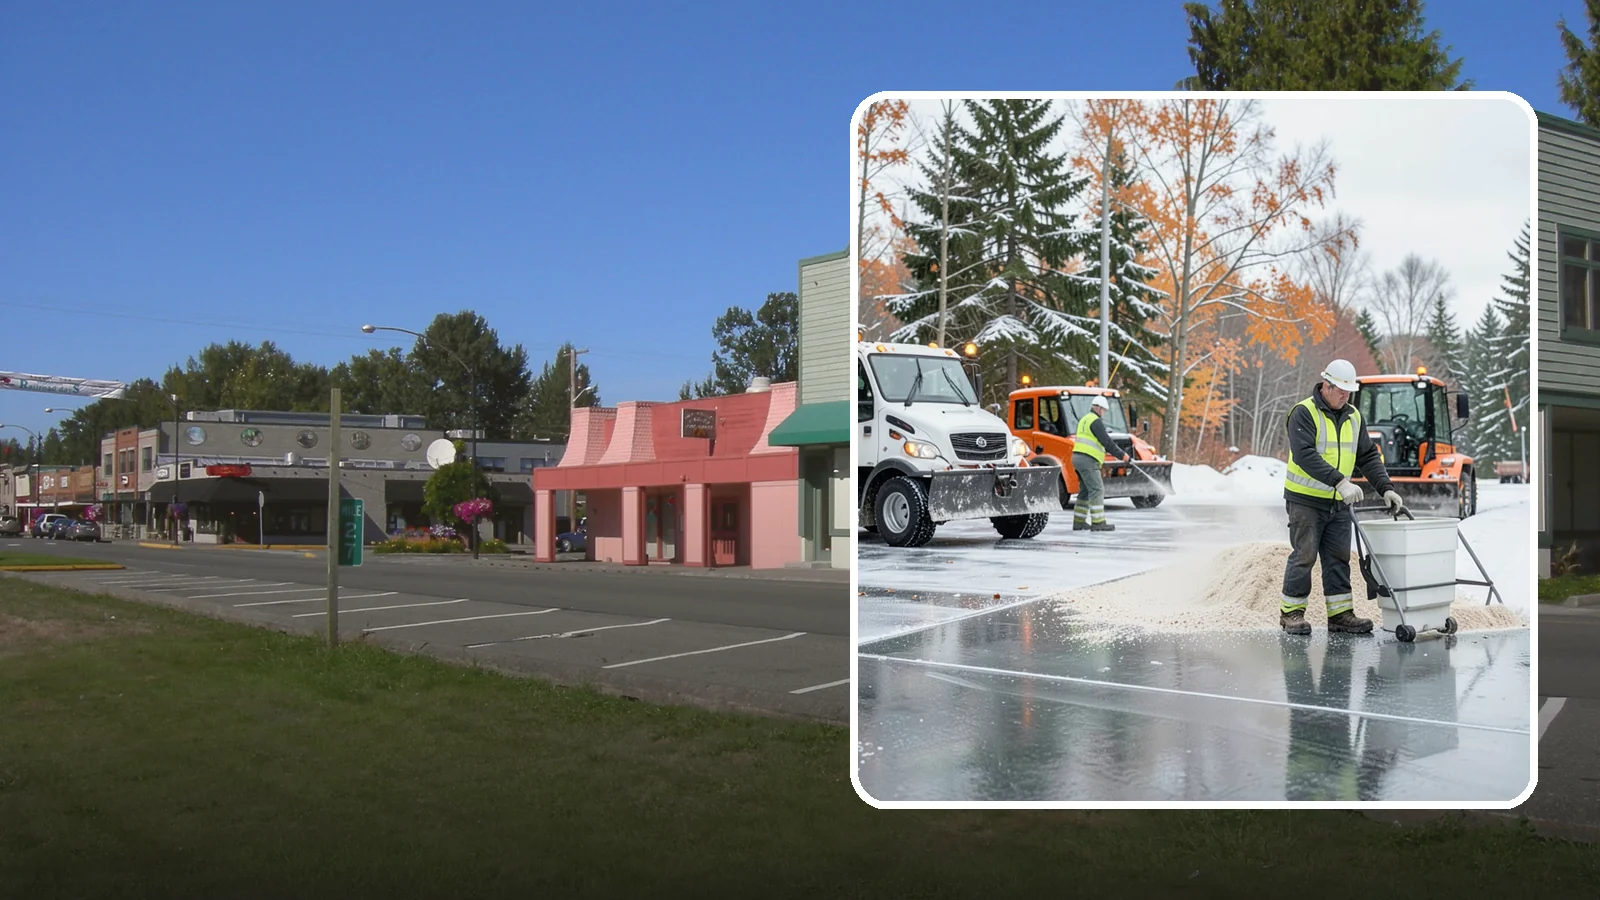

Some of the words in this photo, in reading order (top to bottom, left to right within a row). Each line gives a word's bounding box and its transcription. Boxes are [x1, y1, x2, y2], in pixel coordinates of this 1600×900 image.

[20, 379, 57, 392] Railroad
[341, 505, 362, 517] MILE
[344, 522, 357, 539] 2
[344, 543, 356, 559] 7
